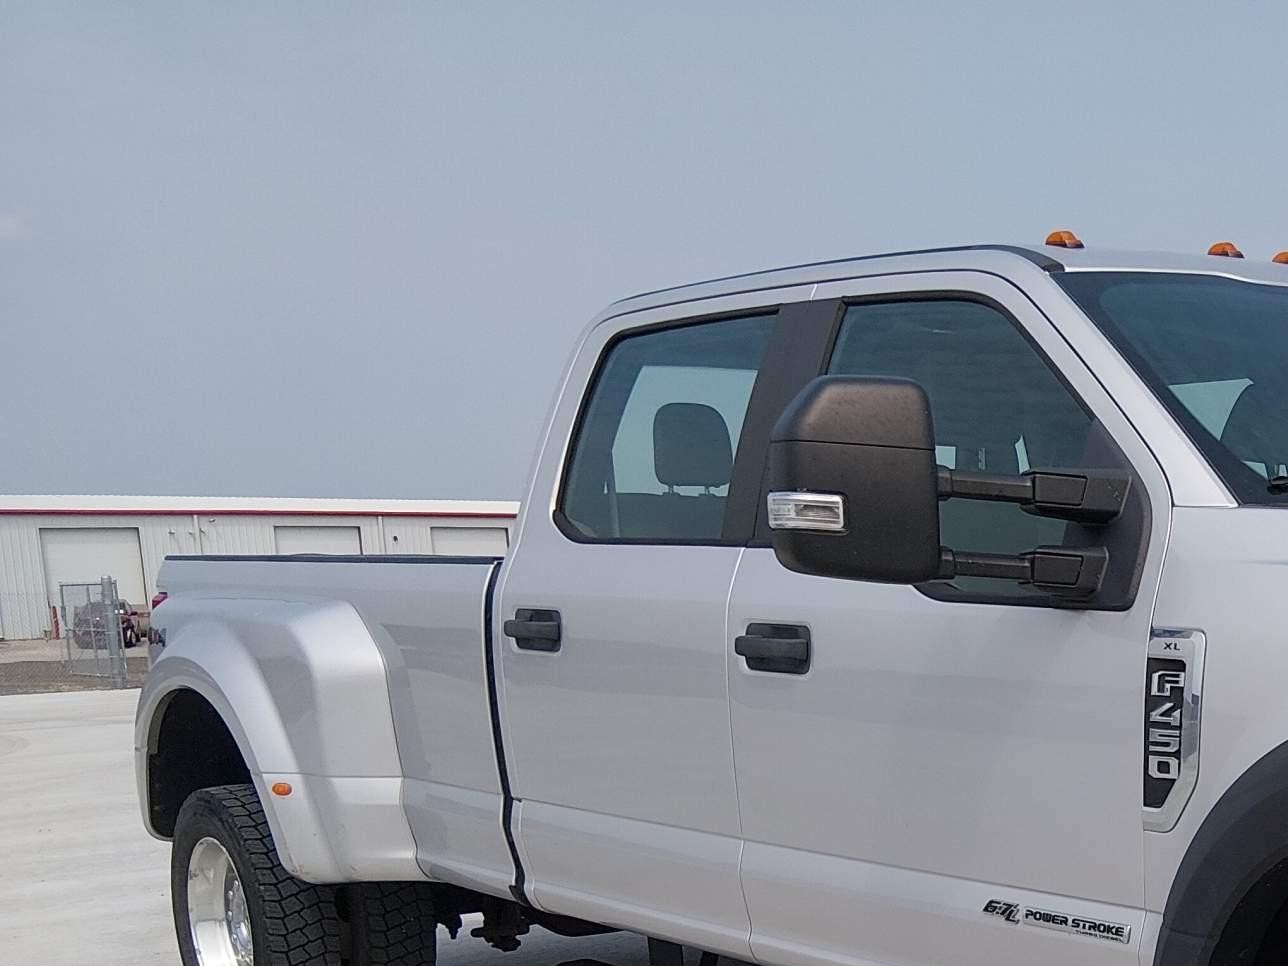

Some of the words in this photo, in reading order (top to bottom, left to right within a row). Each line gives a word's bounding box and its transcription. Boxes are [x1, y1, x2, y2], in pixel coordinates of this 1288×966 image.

[1163, 642, 1181, 651] XL
[1025, 909, 1069, 927] POWER
[1071, 918, 1125, 938] STROKE
